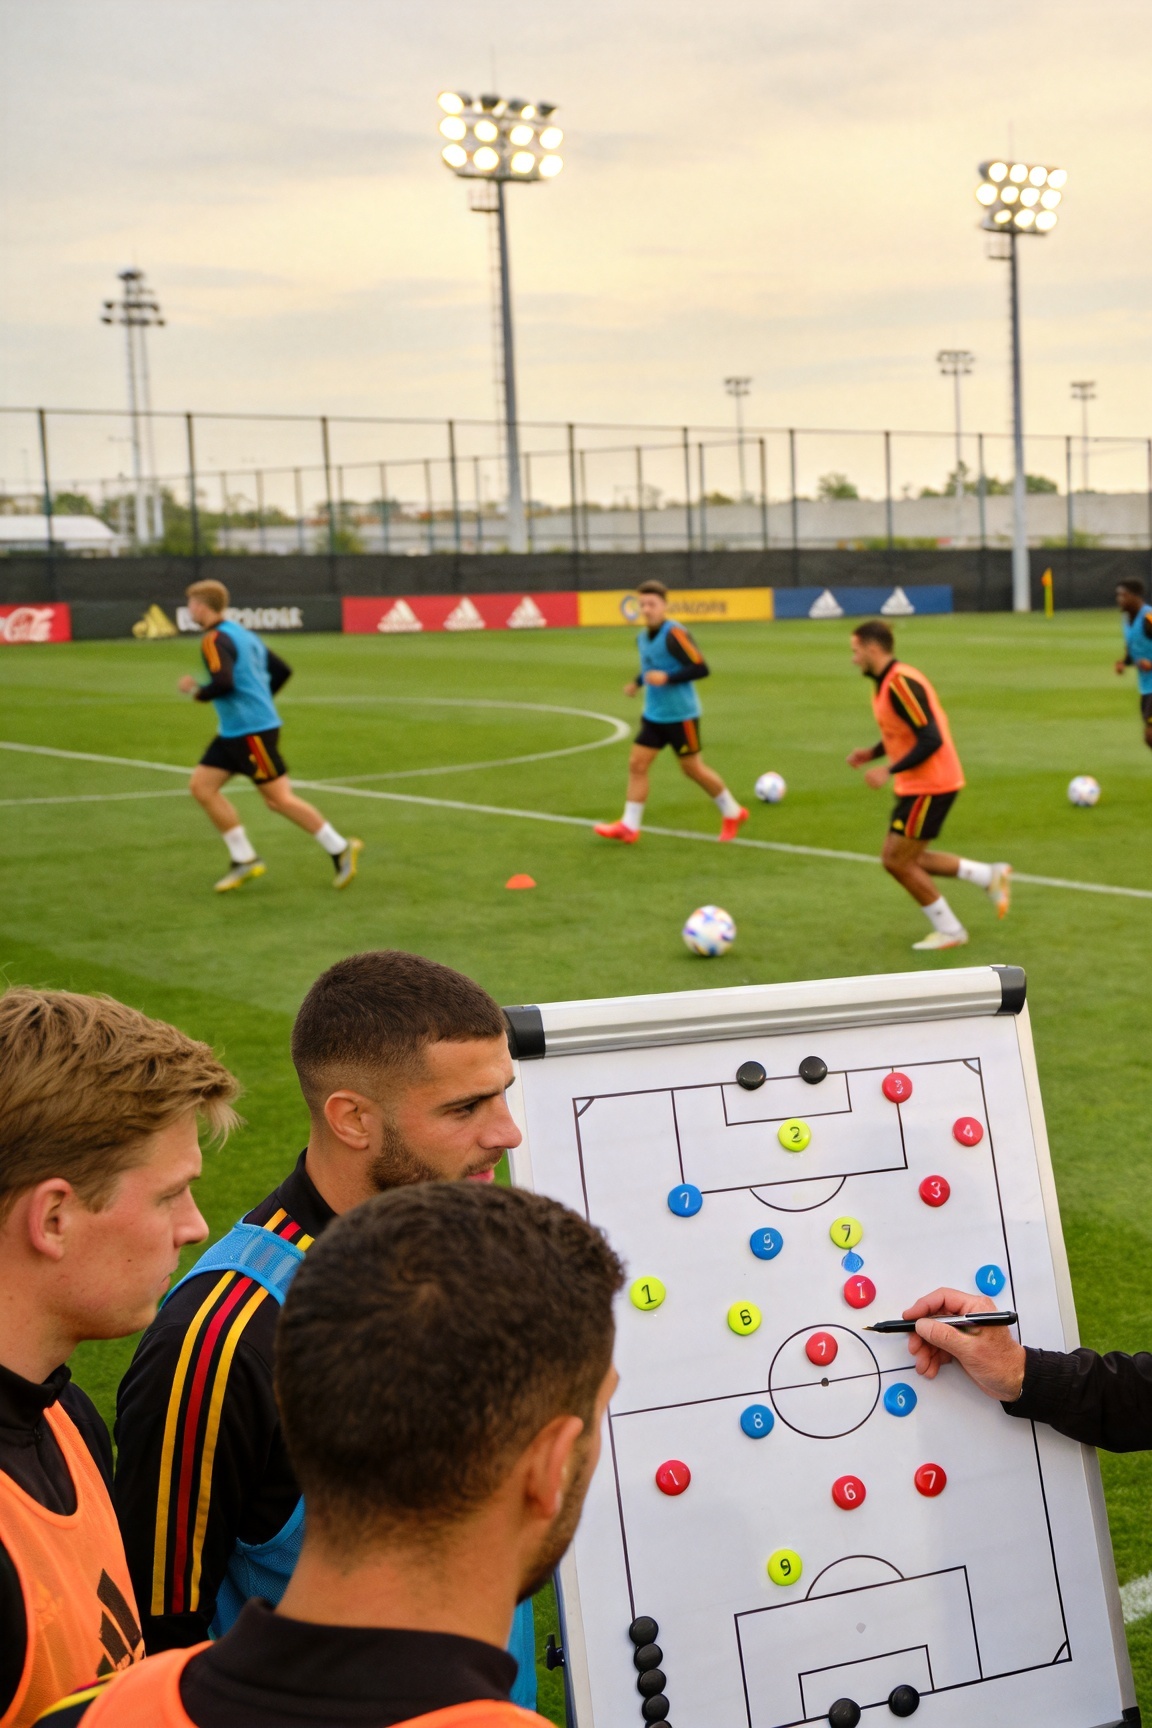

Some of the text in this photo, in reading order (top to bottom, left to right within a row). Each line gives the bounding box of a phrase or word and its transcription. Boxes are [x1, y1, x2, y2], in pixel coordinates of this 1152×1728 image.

[790, 1127, 803, 1143] 2
[931, 1182, 941, 1198] 3
[841, 1224, 851, 1242] 7
[641, 1284, 658, 1304] 1
[753, 1412, 764, 1429] 8
[923, 1470, 936, 1490] 7
[843, 1482, 856, 1501] 6
[780, 1558, 791, 1577] 9
